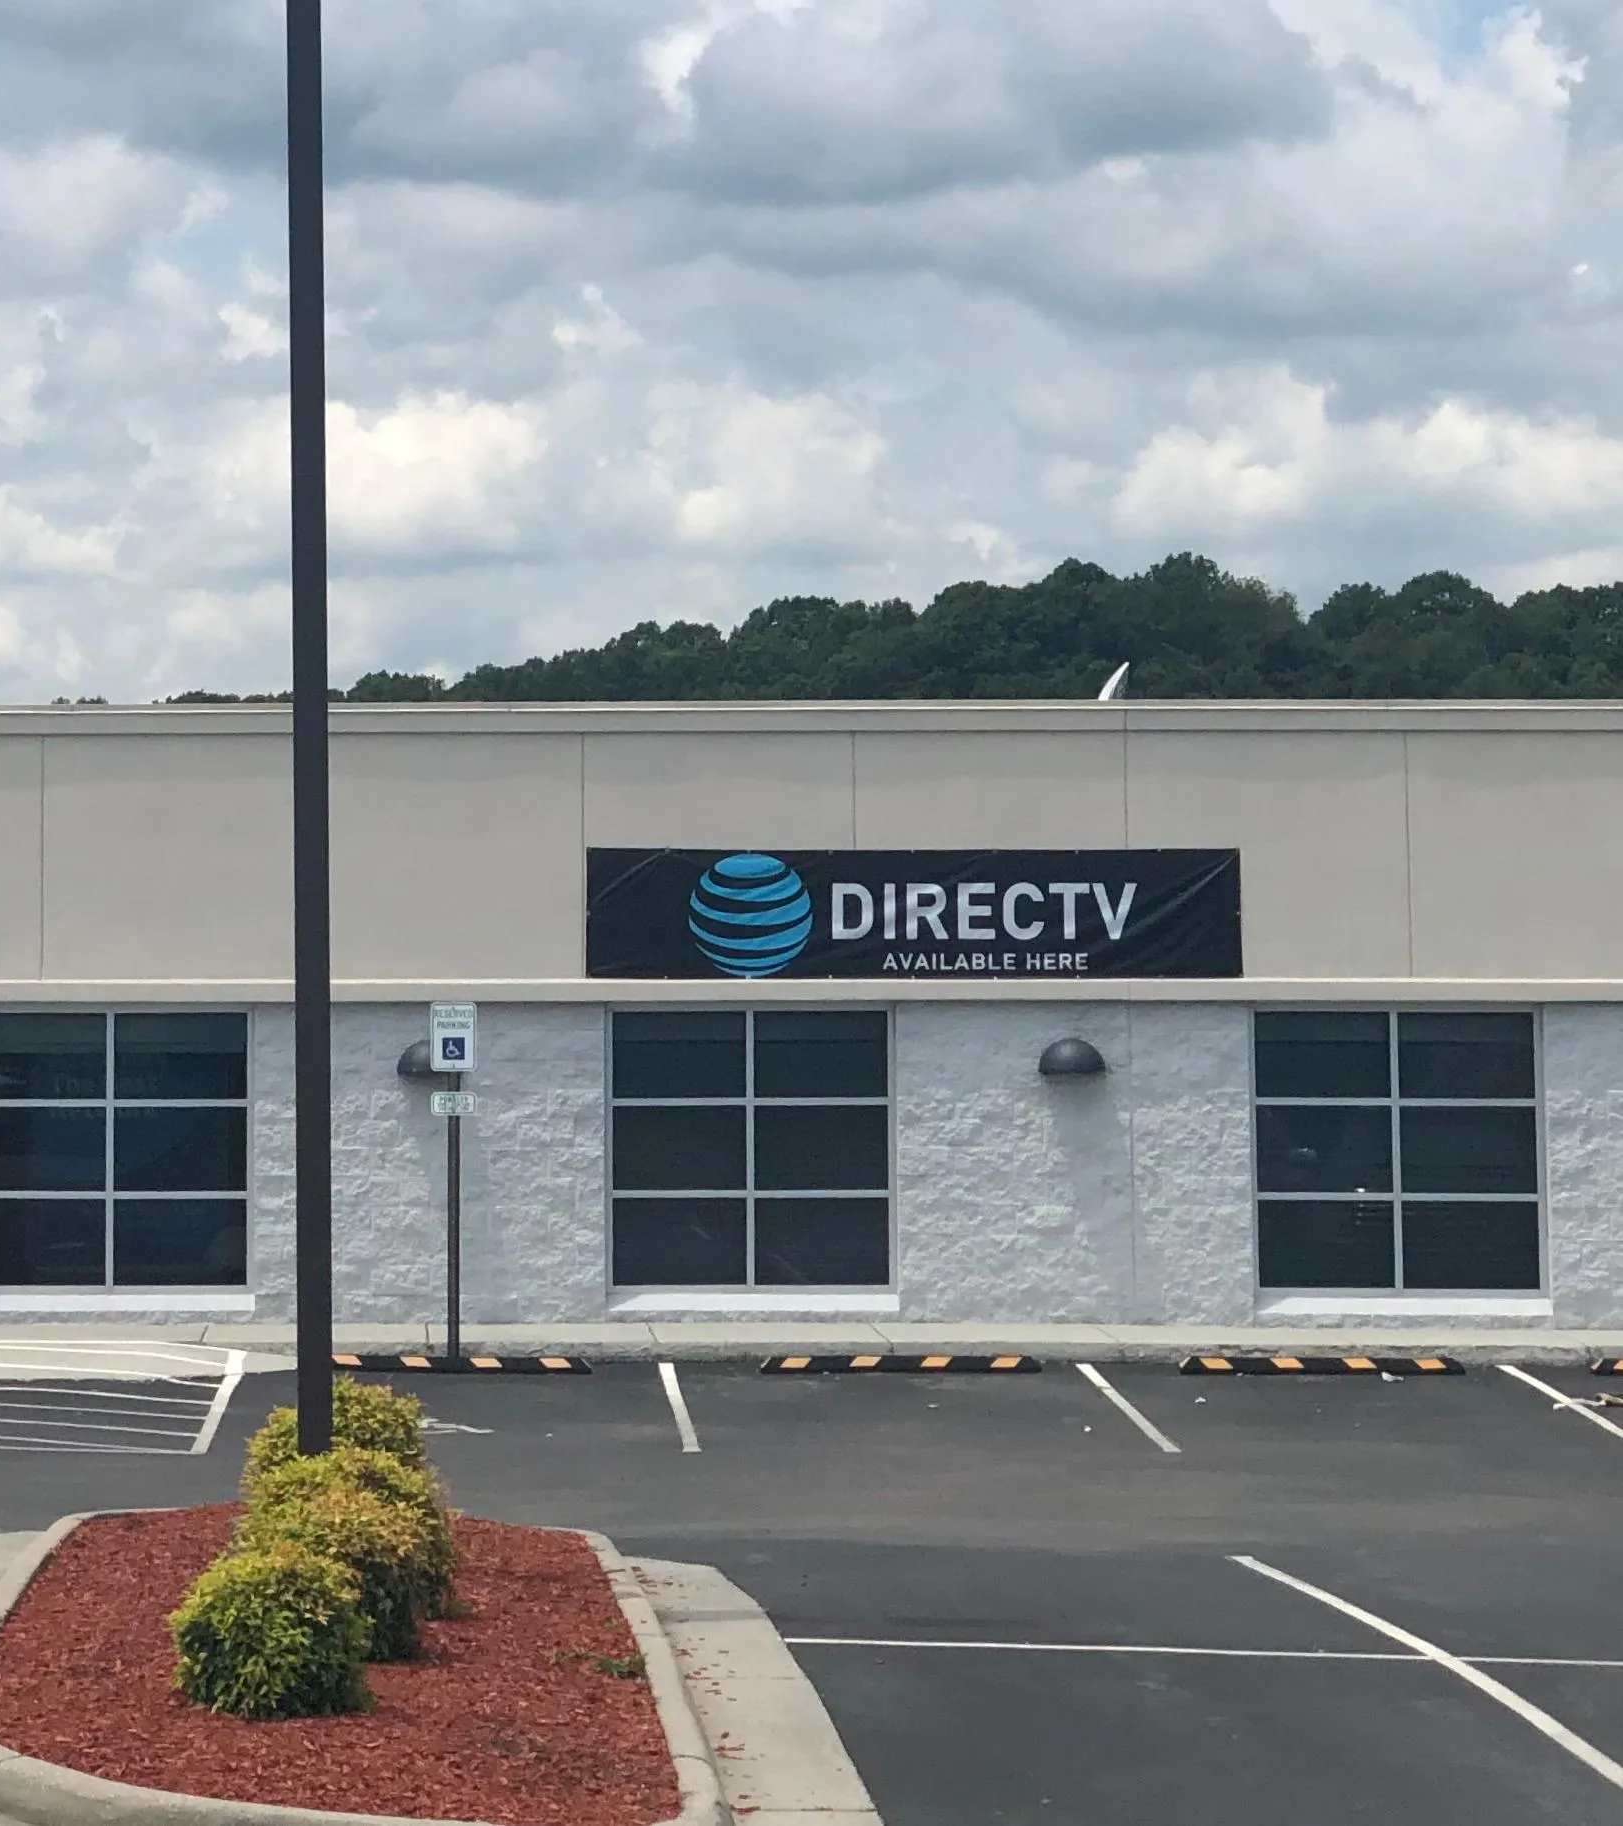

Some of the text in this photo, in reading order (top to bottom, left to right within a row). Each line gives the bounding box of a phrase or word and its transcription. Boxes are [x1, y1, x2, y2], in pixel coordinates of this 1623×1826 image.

[831, 882, 1137, 940] DIRECTV
[882, 952, 1090, 971] AVAILABLE HERE
[437, 1021, 471, 1030] PARKING
